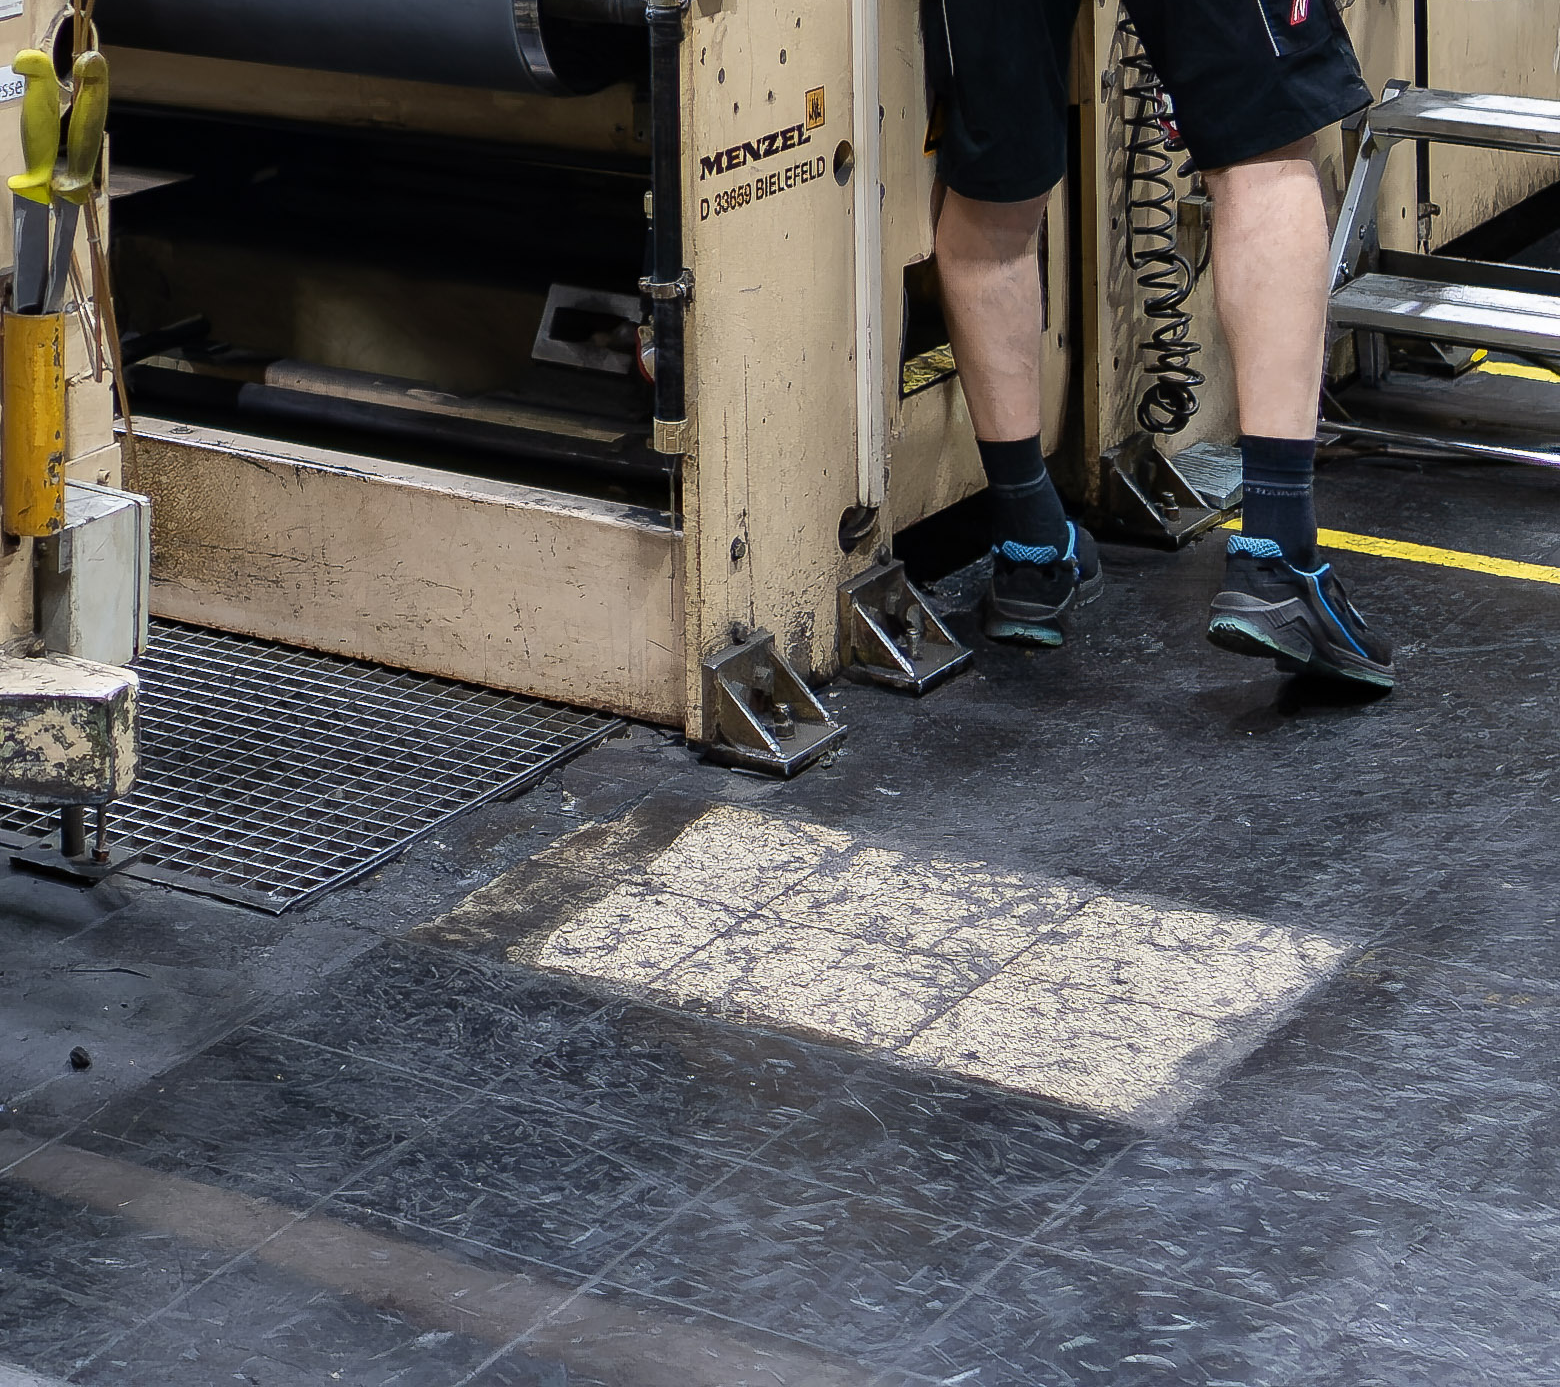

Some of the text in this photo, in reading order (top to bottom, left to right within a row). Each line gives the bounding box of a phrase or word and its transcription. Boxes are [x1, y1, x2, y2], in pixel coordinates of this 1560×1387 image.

[700, 122, 811, 181] MENZEL
[700, 156, 826, 221] D 33659 BIELEFELD
